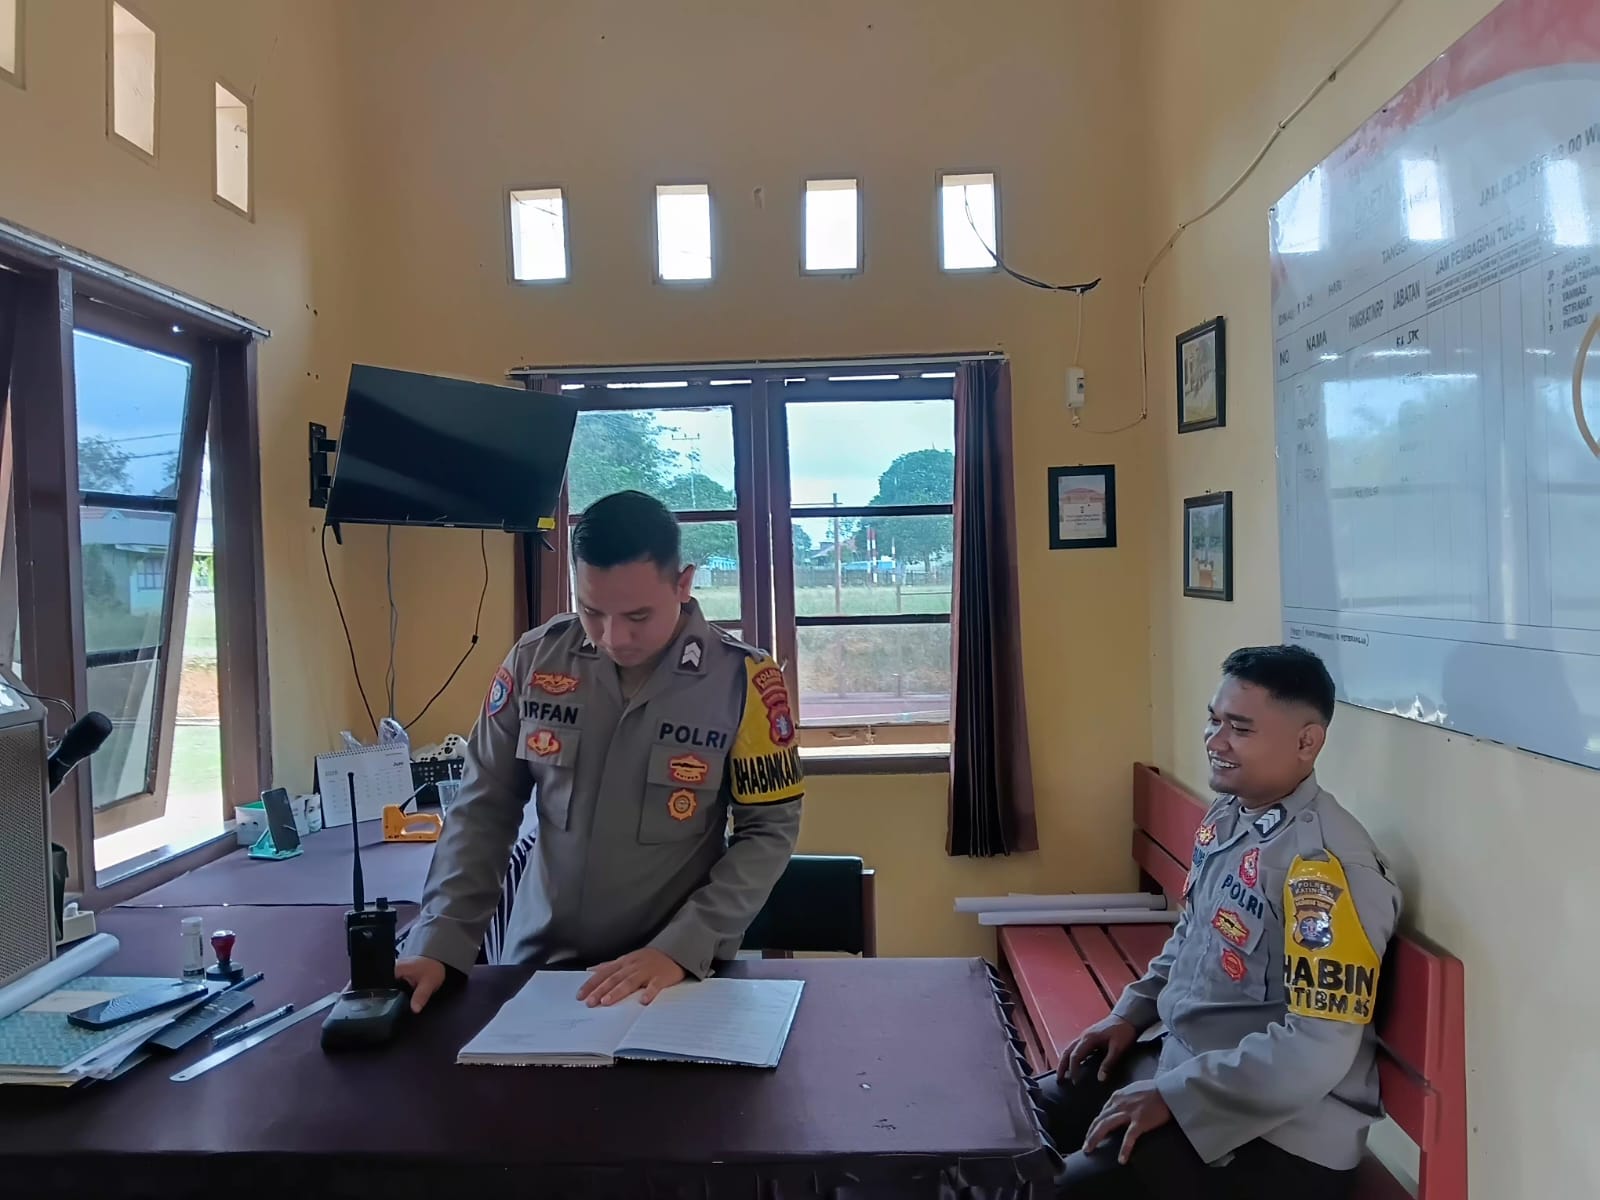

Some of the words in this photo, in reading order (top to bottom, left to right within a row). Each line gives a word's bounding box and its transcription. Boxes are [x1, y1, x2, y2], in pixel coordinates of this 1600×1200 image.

[1450, 232, 1497, 267] PEMBAGIAN
[1306, 329, 1328, 352] NAMA
[1392, 280, 1421, 311] JABATAN
[523, 701, 579, 725] IRFAN
[659, 722, 728, 749] POLRI
[1221, 873, 1265, 920] POLRI
